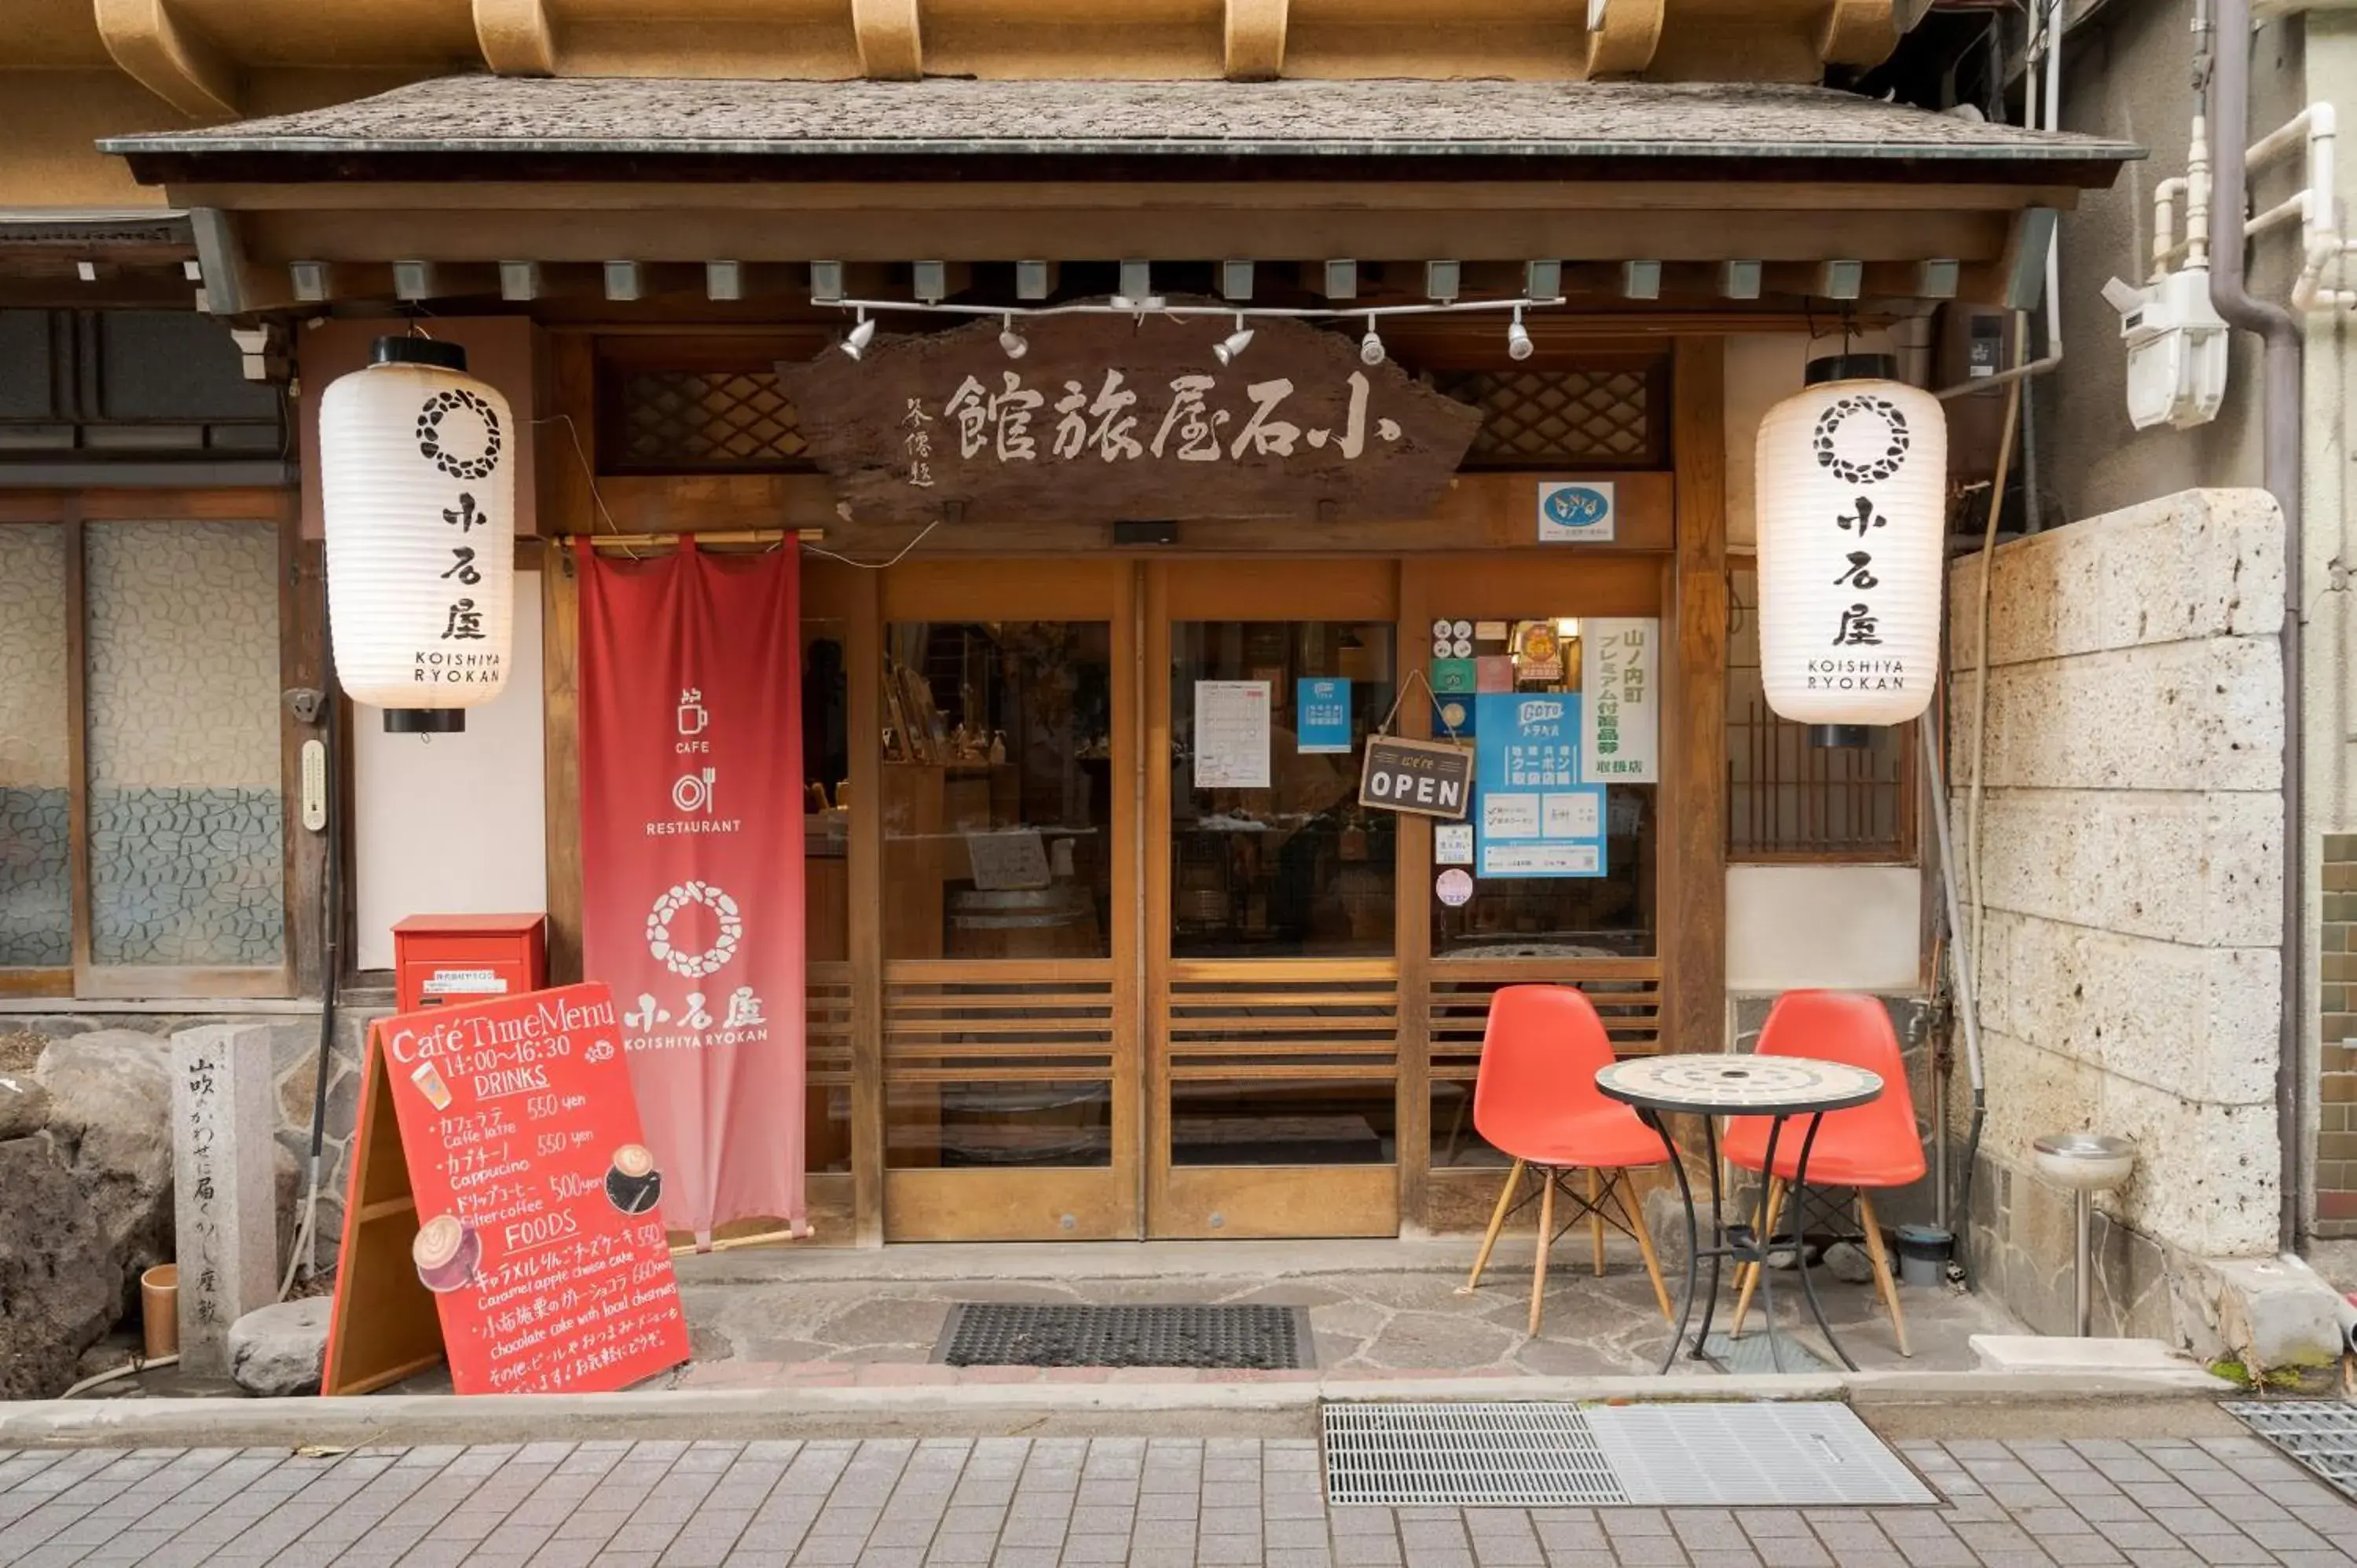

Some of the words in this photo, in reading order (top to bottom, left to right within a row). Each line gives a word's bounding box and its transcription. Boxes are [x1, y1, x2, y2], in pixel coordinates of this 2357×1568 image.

[441, 493, 487, 640] 小石屋
[1832, 496, 1886, 647] 小石屋
[416, 651, 500, 665] KOISHIYA
[1624, 629, 1644, 703] 山ノ内町
[1808, 660, 1903, 673] KOISHIYA
[415, 669, 499, 683] RYOKAN
[1807, 676, 1904, 690] RYOKAN
[675, 740, 710, 754] CAFE
[1512, 757, 1571, 771] クーポン
[1371, 771, 1460, 808] OPEN
[646, 819, 742, 835] RESTAURANT
[624, 986, 769, 1034] 小石屋
[392, 1017, 464, 1064] Café
[537, 998, 616, 1035] Menu
[624, 1035, 702, 1054] KOISHIYA
[706, 1030, 768, 1047] RYOKAN
[475, 1065, 549, 1097] DRINKS
[439, 1107, 503, 1135] カフェラテ
[527, 1094, 559, 1120] 550
[561, 1094, 586, 1110] yen
[484, 1121, 517, 1139] latte
[445, 1141, 509, 1177] カプチーノ
[537, 1132, 566, 1156] 550
[571, 1129, 595, 1149] yen
[499, 1199, 544, 1222] coffee
[504, 1208, 577, 1251] FOODS
[533, 1269, 569, 1293] apple
